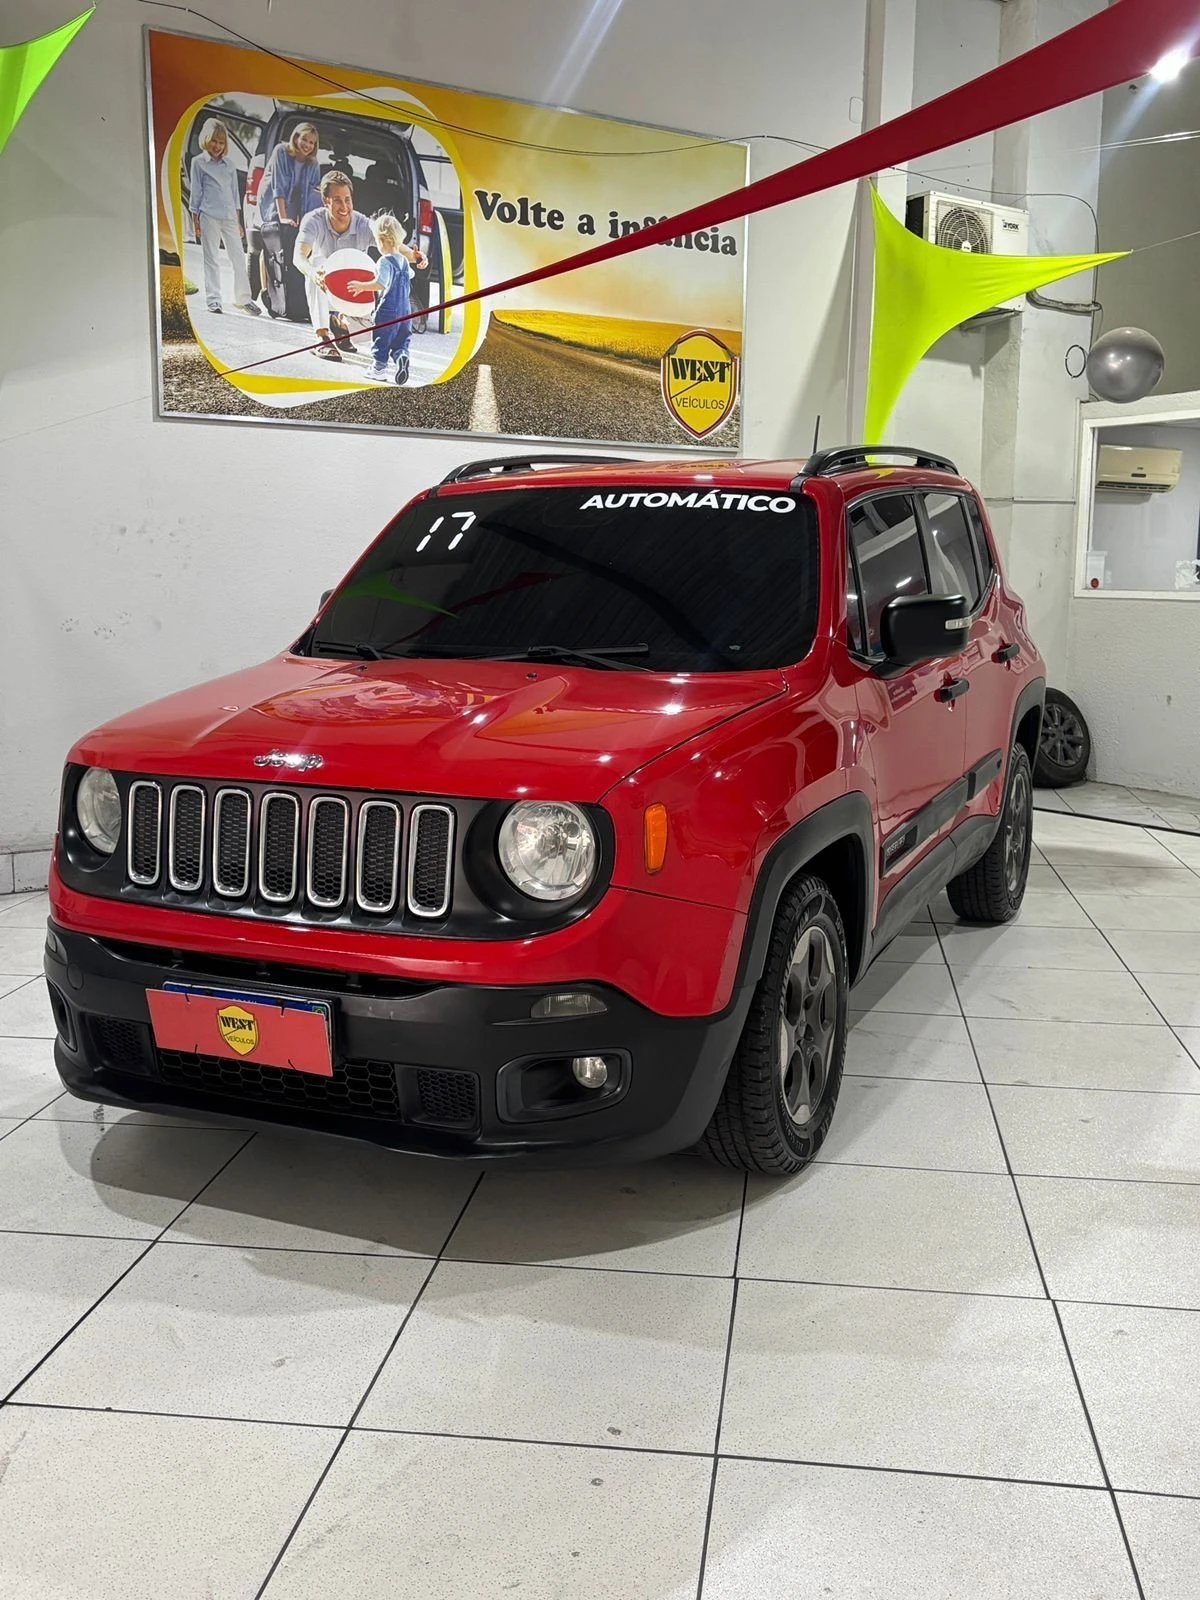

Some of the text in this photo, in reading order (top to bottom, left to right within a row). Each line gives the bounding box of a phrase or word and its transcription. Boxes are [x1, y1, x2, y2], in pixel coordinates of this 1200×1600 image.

[474, 190, 565, 230] Volte
[577, 213, 596, 236] a
[671, 357, 730, 383] WEST
[675, 395, 725, 410] VEÍCULOS
[579, 488, 797, 514] AUTOMÁTICO
[415, 510, 478, 553] 17
[253, 749, 324, 772] Jeep
[219, 1015, 255, 1031] WEST
